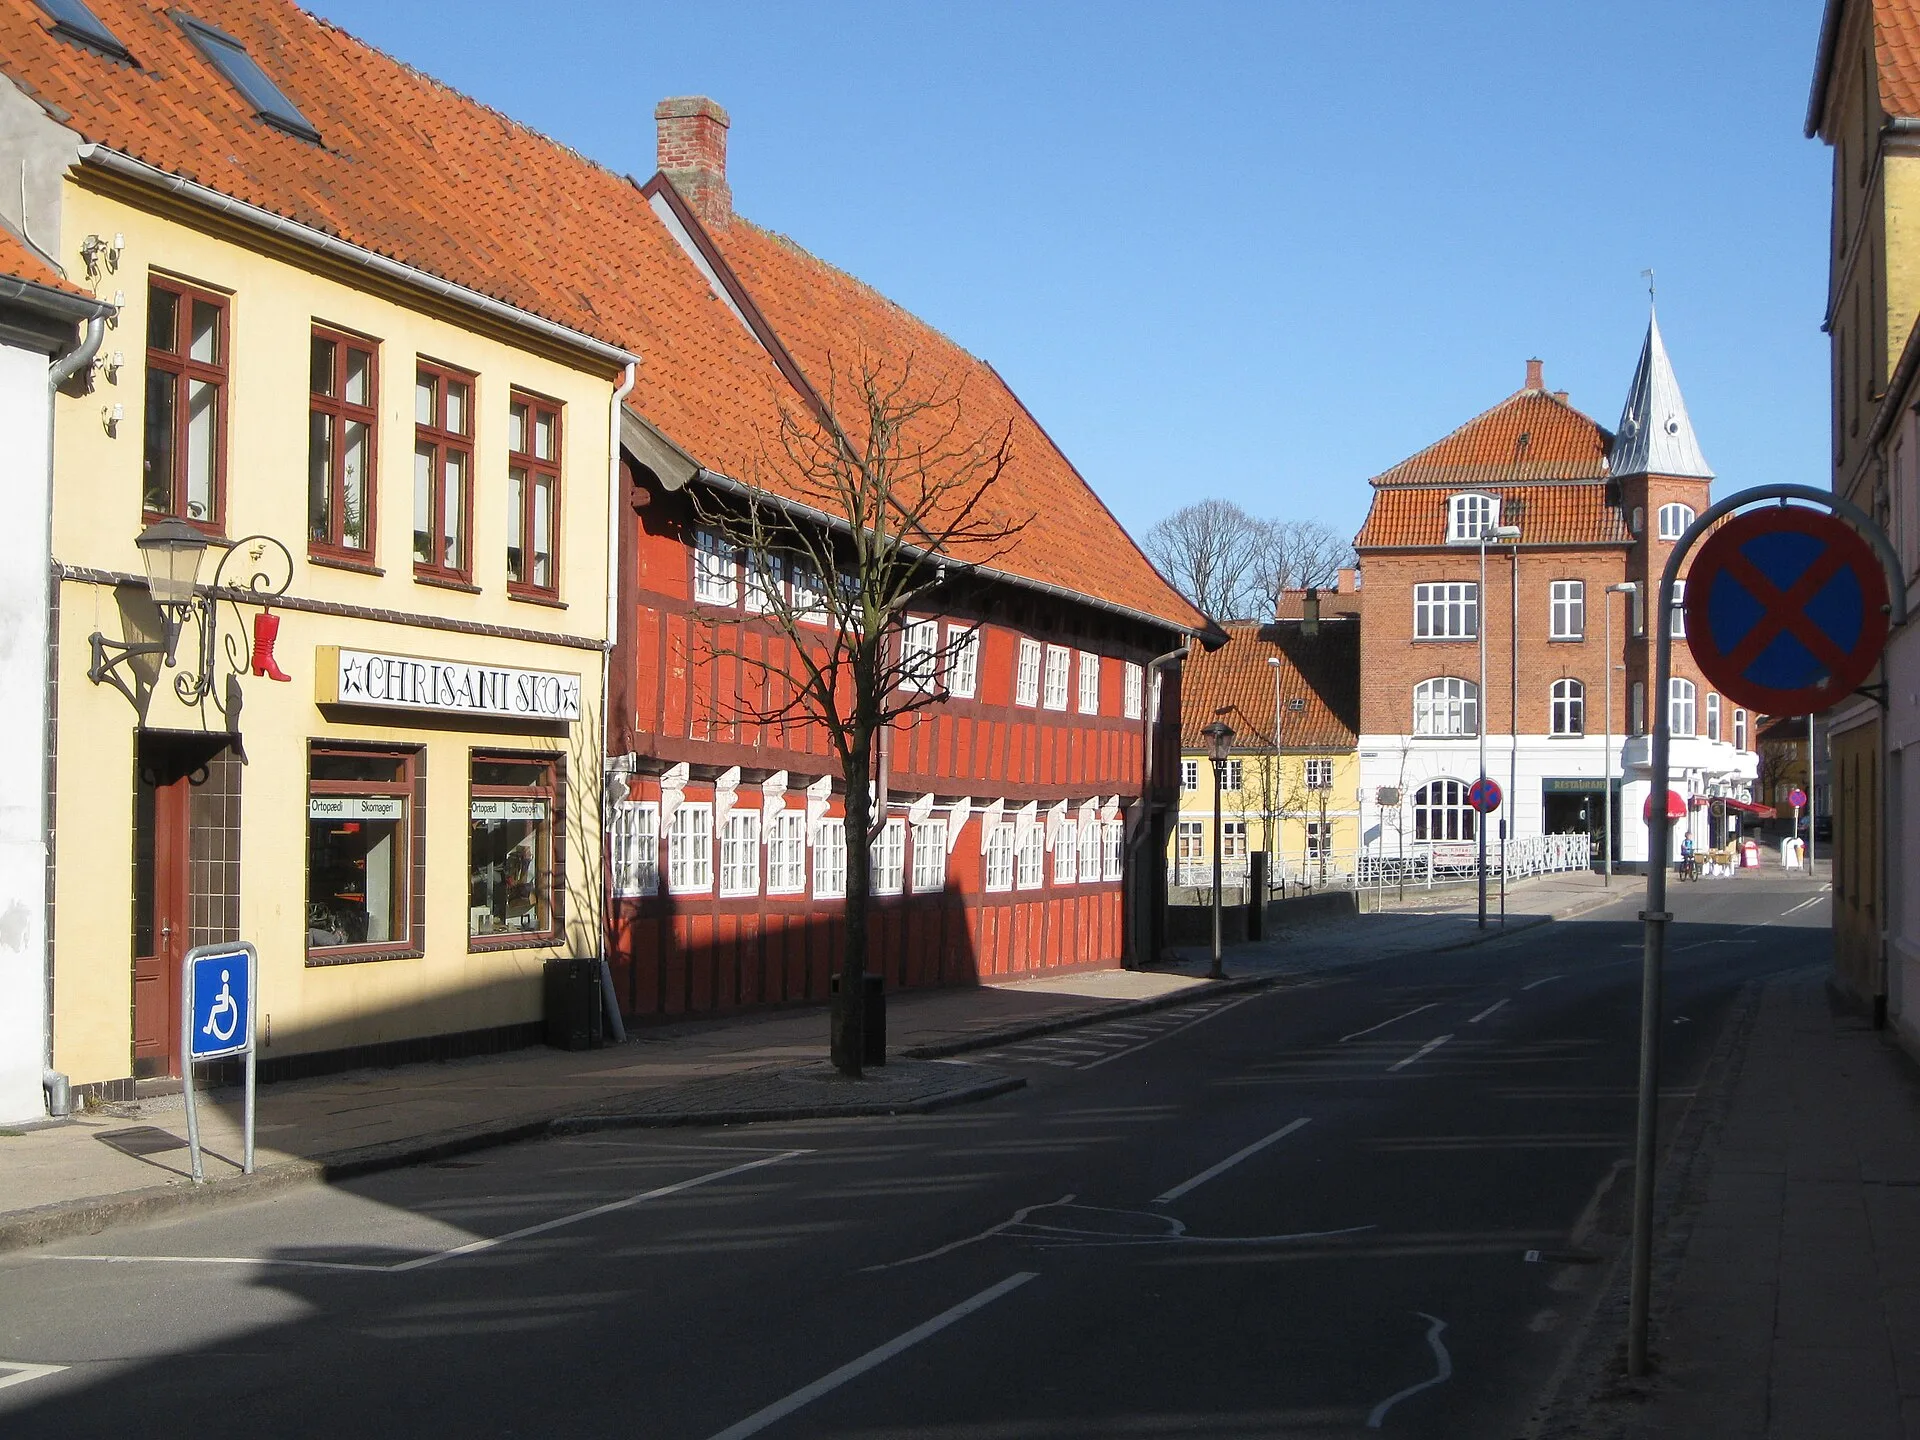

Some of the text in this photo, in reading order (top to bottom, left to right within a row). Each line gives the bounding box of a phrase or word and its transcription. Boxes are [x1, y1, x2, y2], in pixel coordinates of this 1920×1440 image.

[366, 656, 561, 714] CHRISANI SKO
[311, 799, 394, 815] Ortopædi Skomageri
[472, 802, 539, 816] Ortopædi Skomageri
